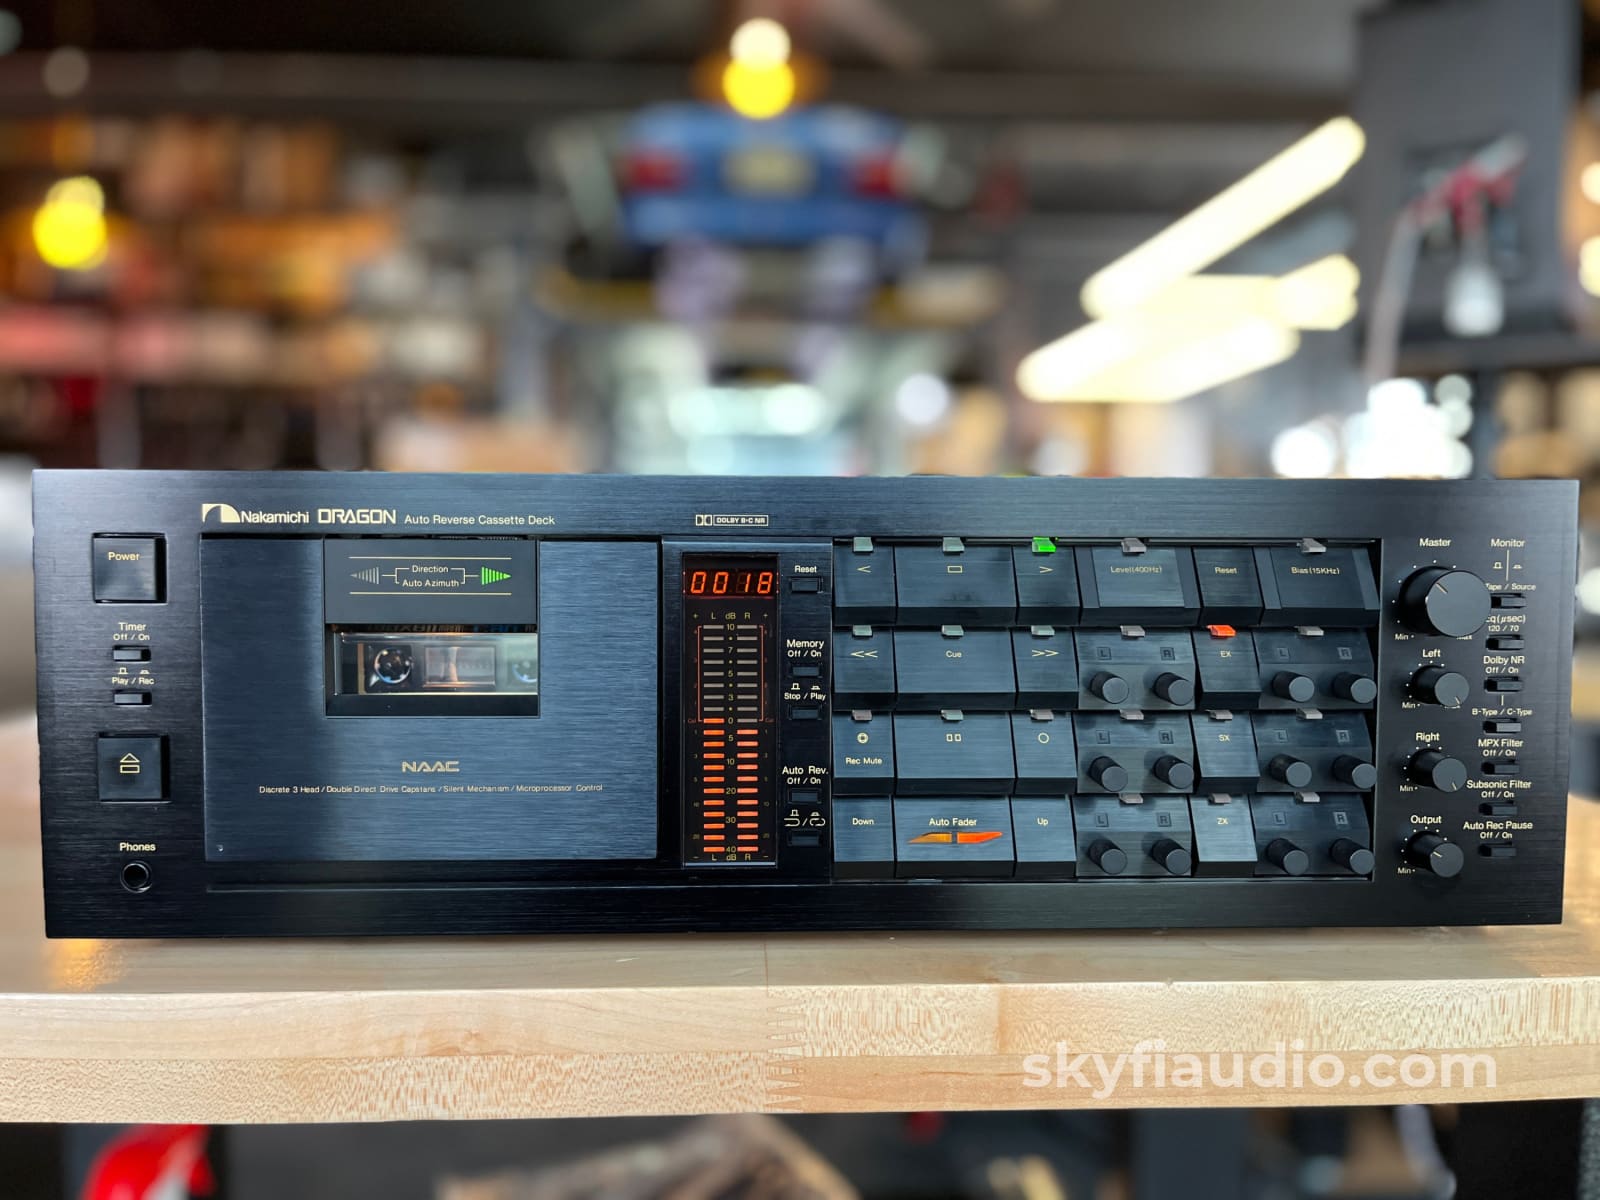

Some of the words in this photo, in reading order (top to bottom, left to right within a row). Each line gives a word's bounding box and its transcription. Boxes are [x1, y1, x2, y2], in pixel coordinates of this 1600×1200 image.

[240, 510, 309, 524] Nakamichi
[317, 509, 396, 524] DRAGON
[404, 514, 430, 524] Auto
[433, 514, 475, 524] Reverse
[478, 515, 525, 525] Cassette
[528, 515, 555, 525] Deck
[1419, 538, 1451, 547] Master
[1491, 538, 1525, 547] Monitor
[108, 551, 140, 561] Power
[412, 565, 449, 573] Direction
[794, 565, 817, 573] Reset
[1215, 566, 1237, 574] Reset
[402, 579, 422, 587] Auto
[425, 579, 459, 587] Azimuth
[690, 571, 774, 594] 0018
[1511, 583, 1536, 591] Source
[725, 612, 737, 620] dB
[118, 622, 147, 631] Timer
[726, 623, 735, 631] 10
[113, 633, 127, 641] Off
[138, 633, 150, 641] On
[787, 639, 825, 649] Memory
[787, 650, 801, 658] Off
[810, 650, 822, 658] On
[945, 650, 962, 658] Cue
[1422, 648, 1441, 658] Left
[1483, 655, 1508, 666] Dolby
[1510, 655, 1525, 664] NR
[1485, 666, 1499, 674] Off
[1508, 666, 1519, 674] On
[112, 677, 129, 685] Play
[139, 677, 154, 685] Rec
[784, 693, 801, 701] Stop
[810, 692, 826, 701] Play
[1472, 708, 1498, 716] B-Type
[1506, 708, 1533, 716] C-Type
[1415, 732, 1440, 743] Right
[1478, 739, 1499, 748] MPX
[1501, 738, 1524, 748] Filter
[845, 757, 861, 765] Rec
[863, 757, 882, 765] Mute
[401, 761, 459, 773] NAAC
[782, 766, 804, 775] Auto
[808, 765, 829, 775] Rev.
[786, 777, 801, 785] Off
[810, 777, 821, 785] On
[1466, 780, 1507, 789] Subsonic
[1509, 779, 1532, 789] Filter
[259, 786, 290, 794] Discrete
[326, 785, 352, 793] Double
[354, 785, 376, 793] Direct
[380, 785, 399, 793] Drive
[443, 785, 464, 793] Silent
[467, 785, 510, 793] Mechanism
[516, 785, 572, 793] Microprocessor
[576, 784, 603, 792] Control
[852, 818, 874, 826] Down
[929, 818, 950, 826] Auto
[952, 817, 977, 826] Fader
[1037, 818, 1049, 826] Up
[1410, 814, 1442, 825] Output
[1463, 821, 1484, 830] Auto
[1486, 821, 1504, 830] Rec
[1505, 821, 1533, 830] Pause
[1480, 831, 1493, 839] Off
[119, 842, 156, 852] Phones
